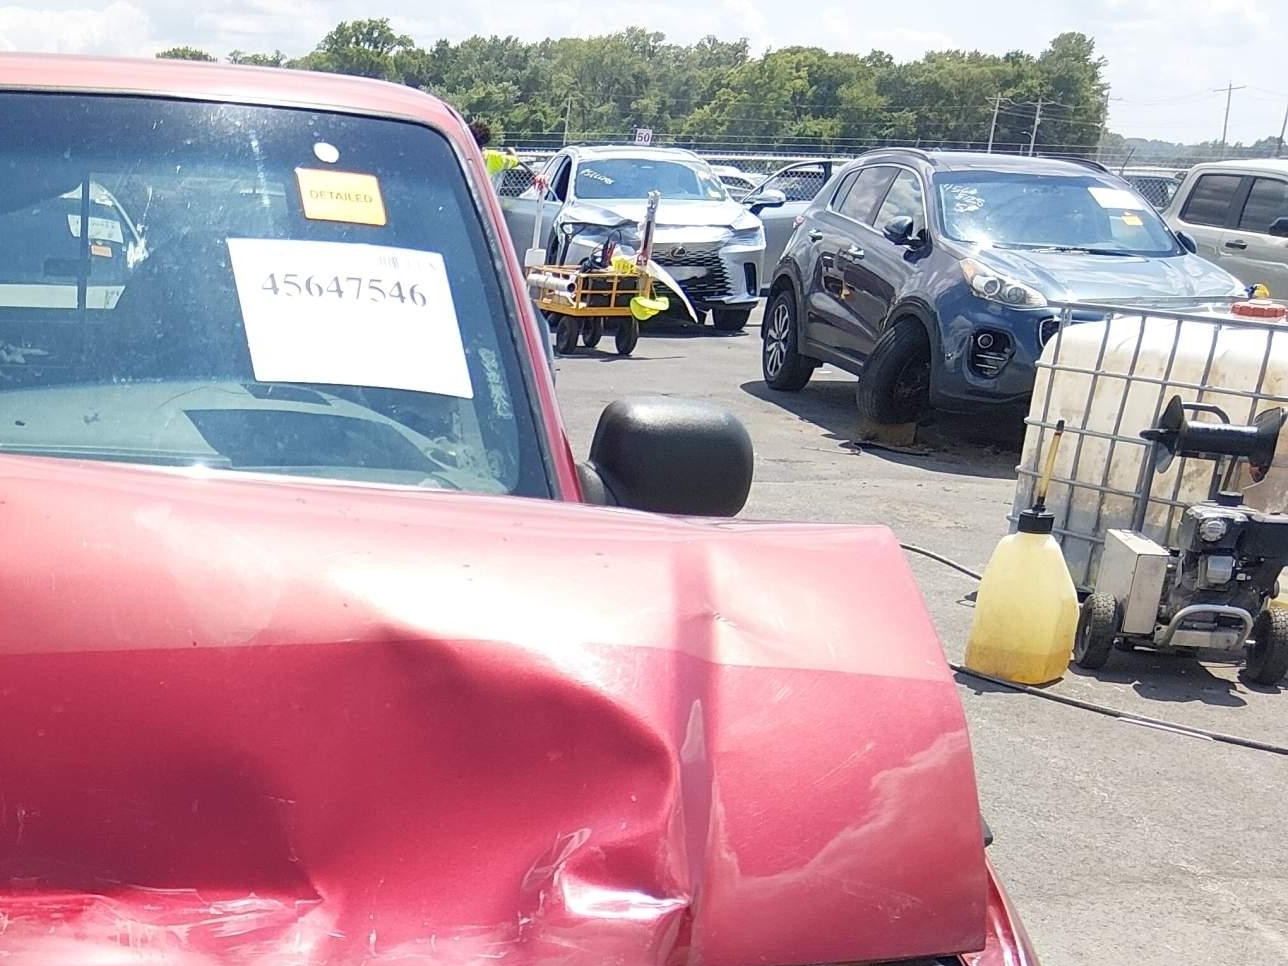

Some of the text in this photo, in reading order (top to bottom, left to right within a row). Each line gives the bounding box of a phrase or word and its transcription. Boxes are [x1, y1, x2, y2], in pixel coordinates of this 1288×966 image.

[637, 132, 650, 143] 50
[309, 188, 374, 204] DETAILED
[262, 273, 427, 307] 45647546
